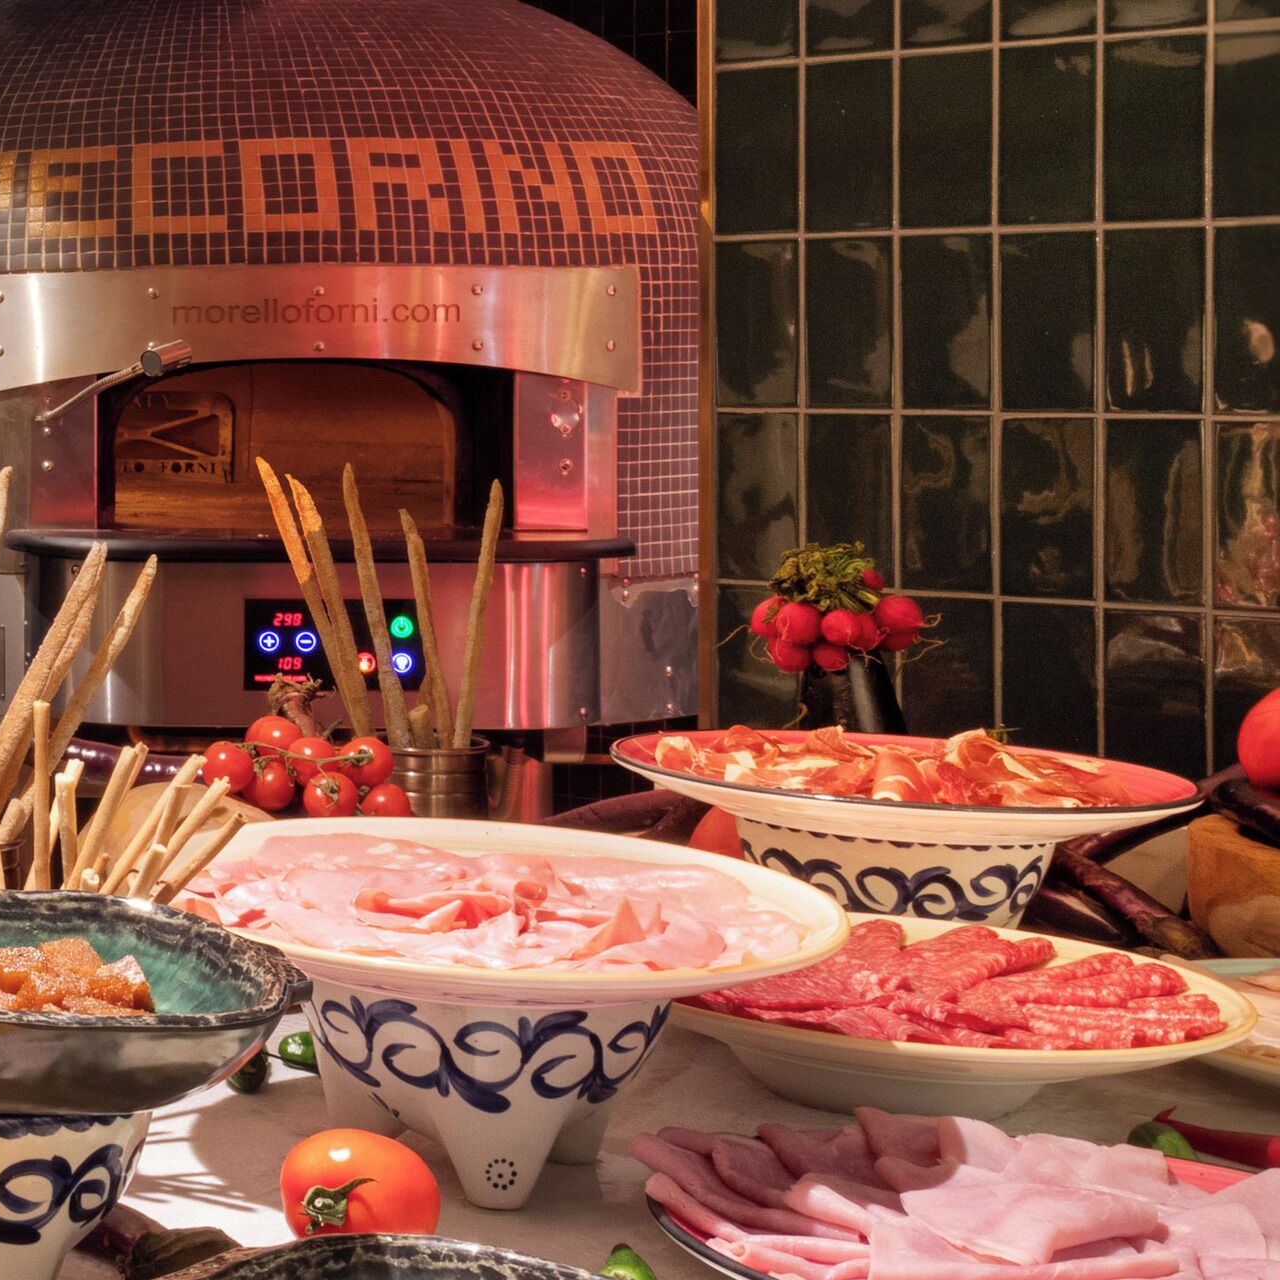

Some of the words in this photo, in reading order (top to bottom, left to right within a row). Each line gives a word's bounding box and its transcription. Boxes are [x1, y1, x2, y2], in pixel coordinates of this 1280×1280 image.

[172, 298, 461, 324] morelloforni.com
[161, 462, 216, 474] FORNI
[273, 613, 303, 627] 298
[278, 657, 302, 670] 109
